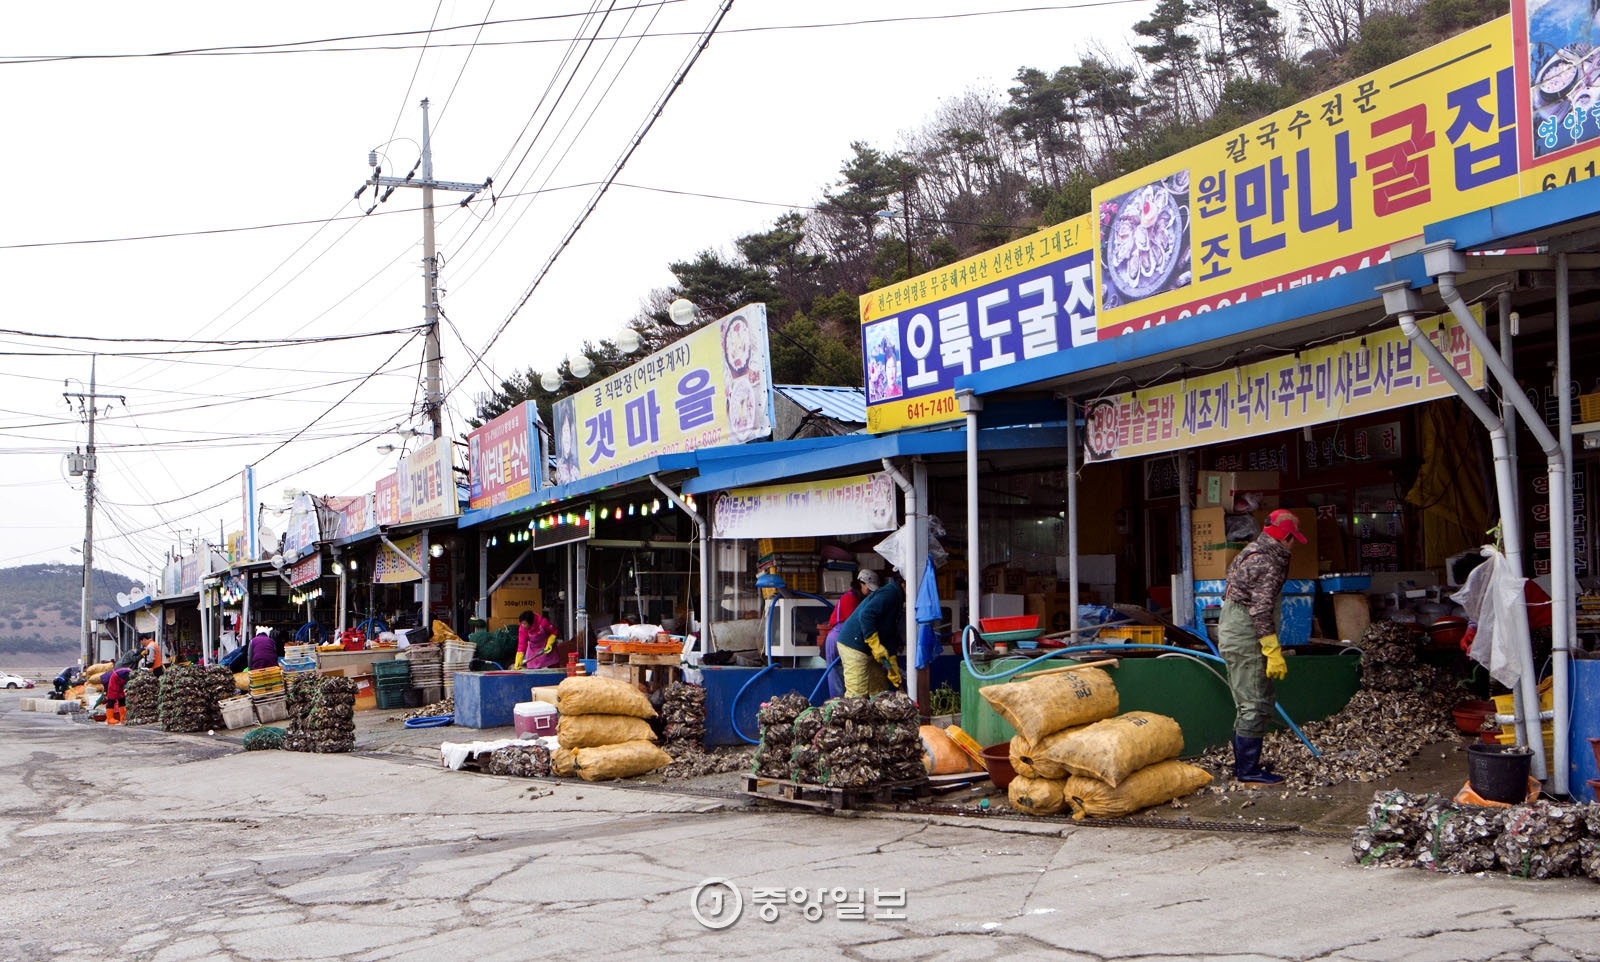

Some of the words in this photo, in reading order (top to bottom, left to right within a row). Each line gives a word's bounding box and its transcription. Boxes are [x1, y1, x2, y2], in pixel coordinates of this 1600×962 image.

[1225, 81, 1380, 164] 칼국수전문
[1538, 101, 1600, 148] 영양
[1235, 66, 1518, 260] 만나굴집
[931, 258, 987, 296] 무공해자연산
[993, 241, 1035, 274] 신선한맛
[1040, 224, 1079, 258] 그대로!
[906, 261, 1098, 390] 오륙도굴집
[584, 368, 717, 466] 갯마을
[594, 388, 602, 407] 굴
[907, 396, 954, 420] 641-7410
